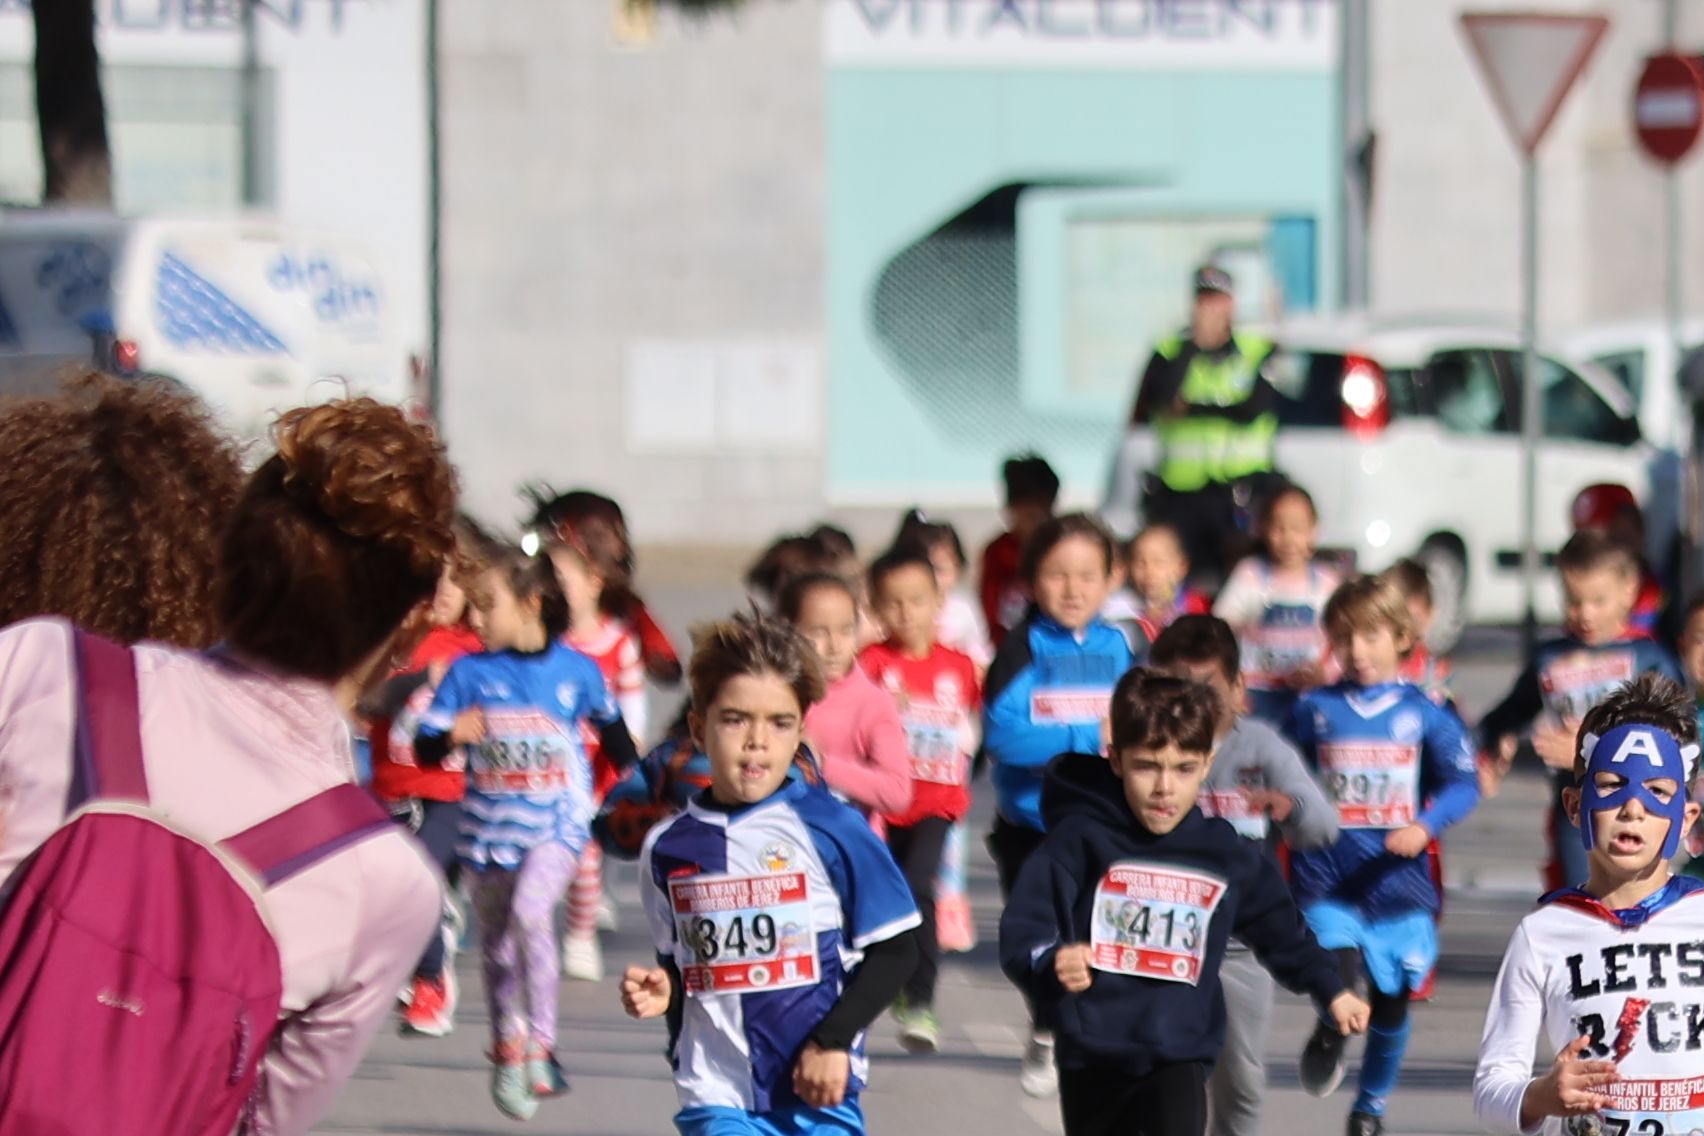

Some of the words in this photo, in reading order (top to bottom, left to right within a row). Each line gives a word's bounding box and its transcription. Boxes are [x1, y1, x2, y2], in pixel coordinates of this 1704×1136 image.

[1611, 730, 1664, 767] A
[699, 913, 778, 962] 349
[1127, 906, 1199, 951] 413
[1609, 1081, 1659, 1097] INFANTIL
[1641, 1097, 1656, 1111] DE
[1657, 1095, 1690, 1111] JEREZ
